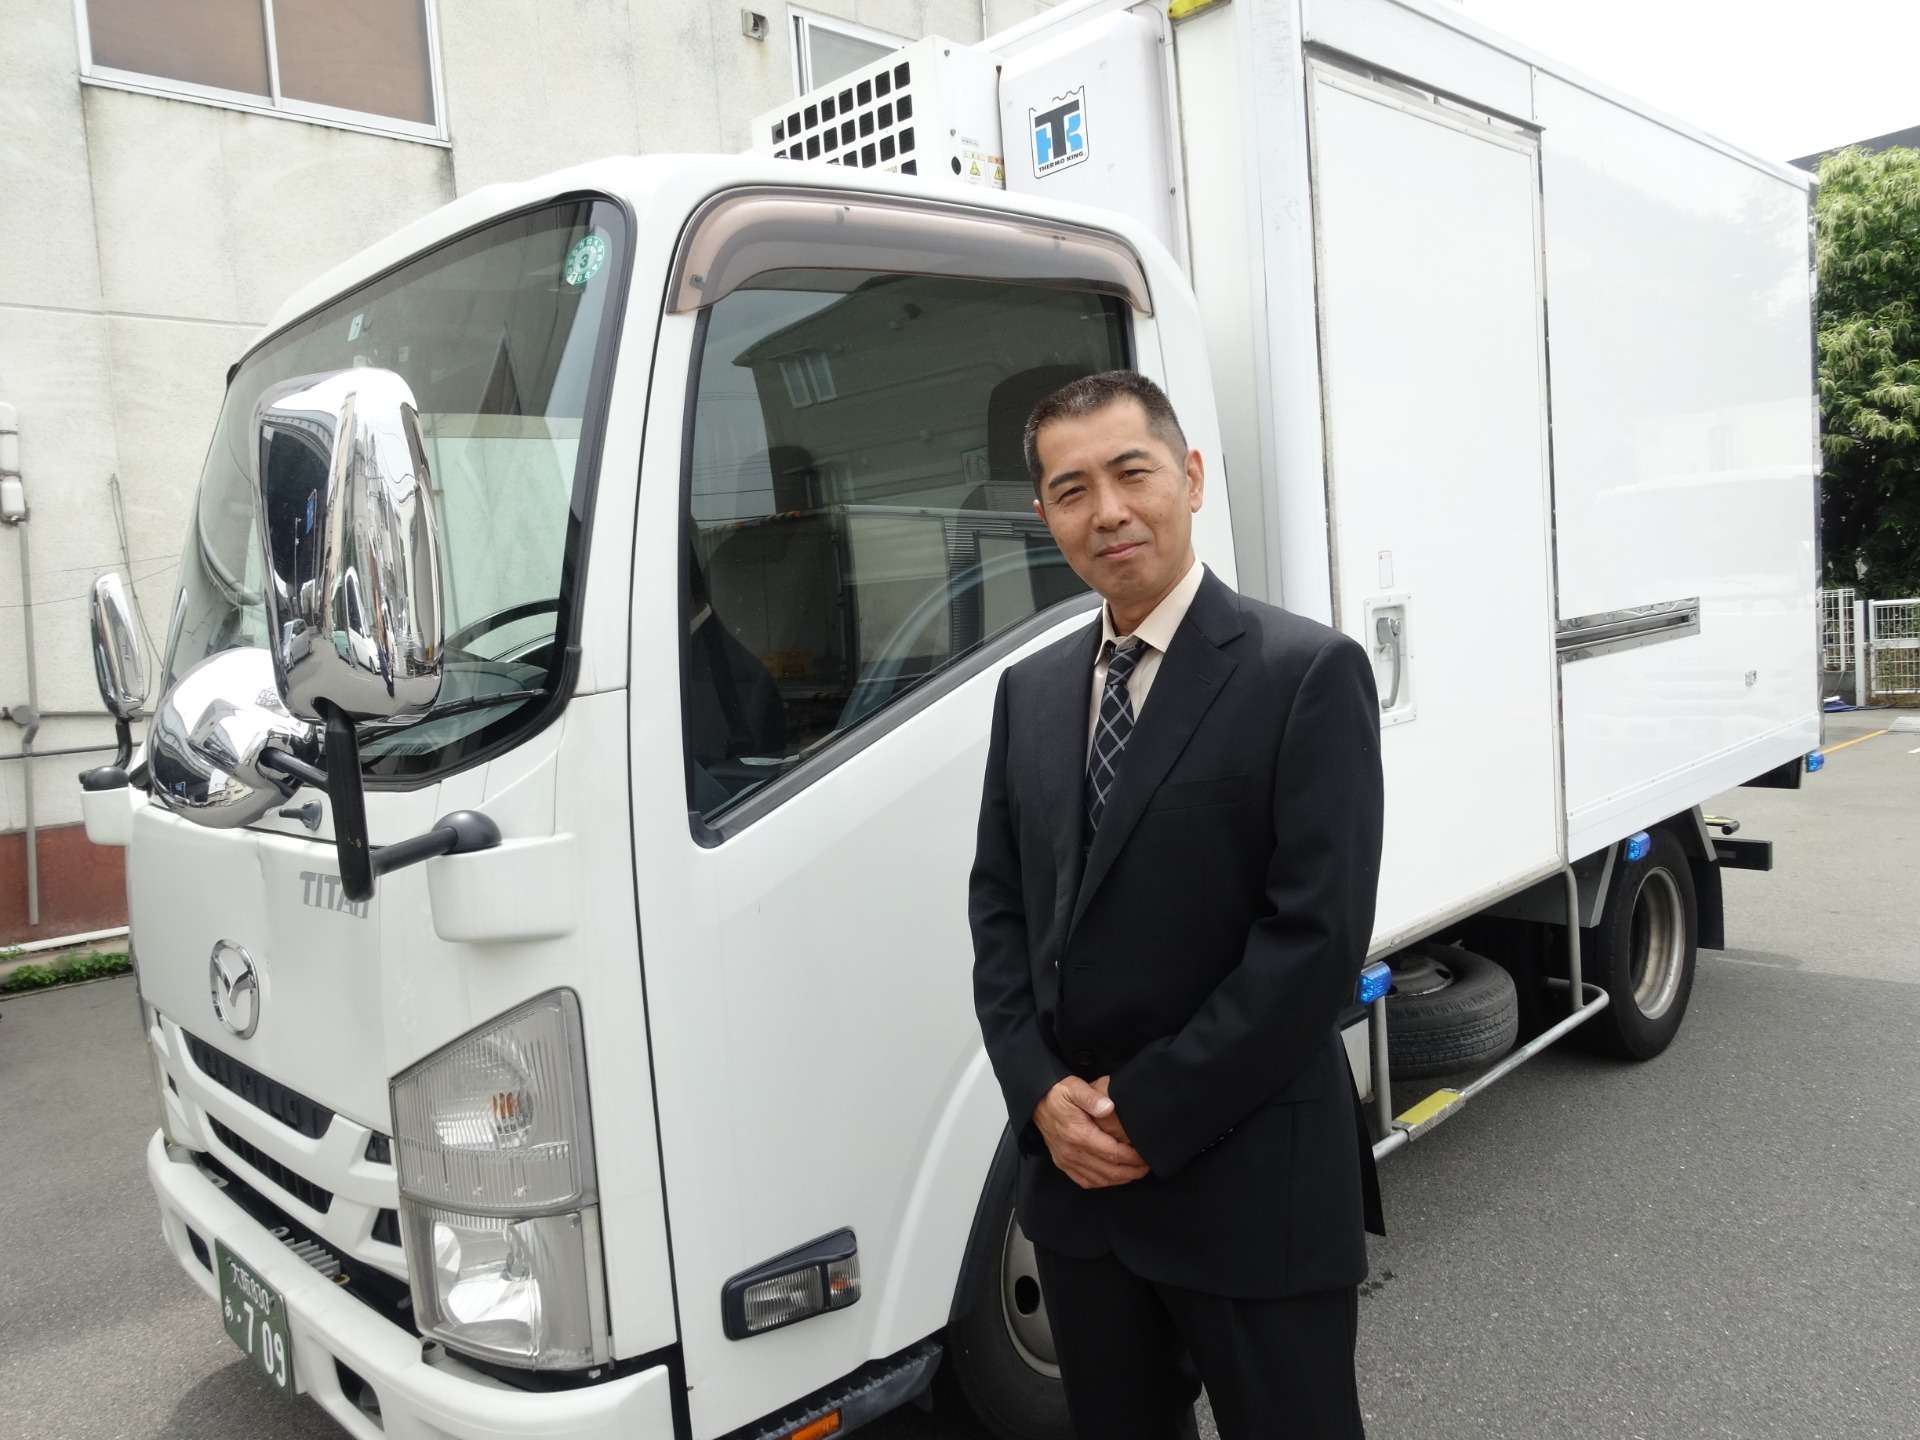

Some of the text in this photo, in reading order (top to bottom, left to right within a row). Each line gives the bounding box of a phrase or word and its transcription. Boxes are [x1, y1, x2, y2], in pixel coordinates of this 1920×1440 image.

[1038, 151, 1084, 172] THERMO KING
[579, 253, 589, 269] 3
